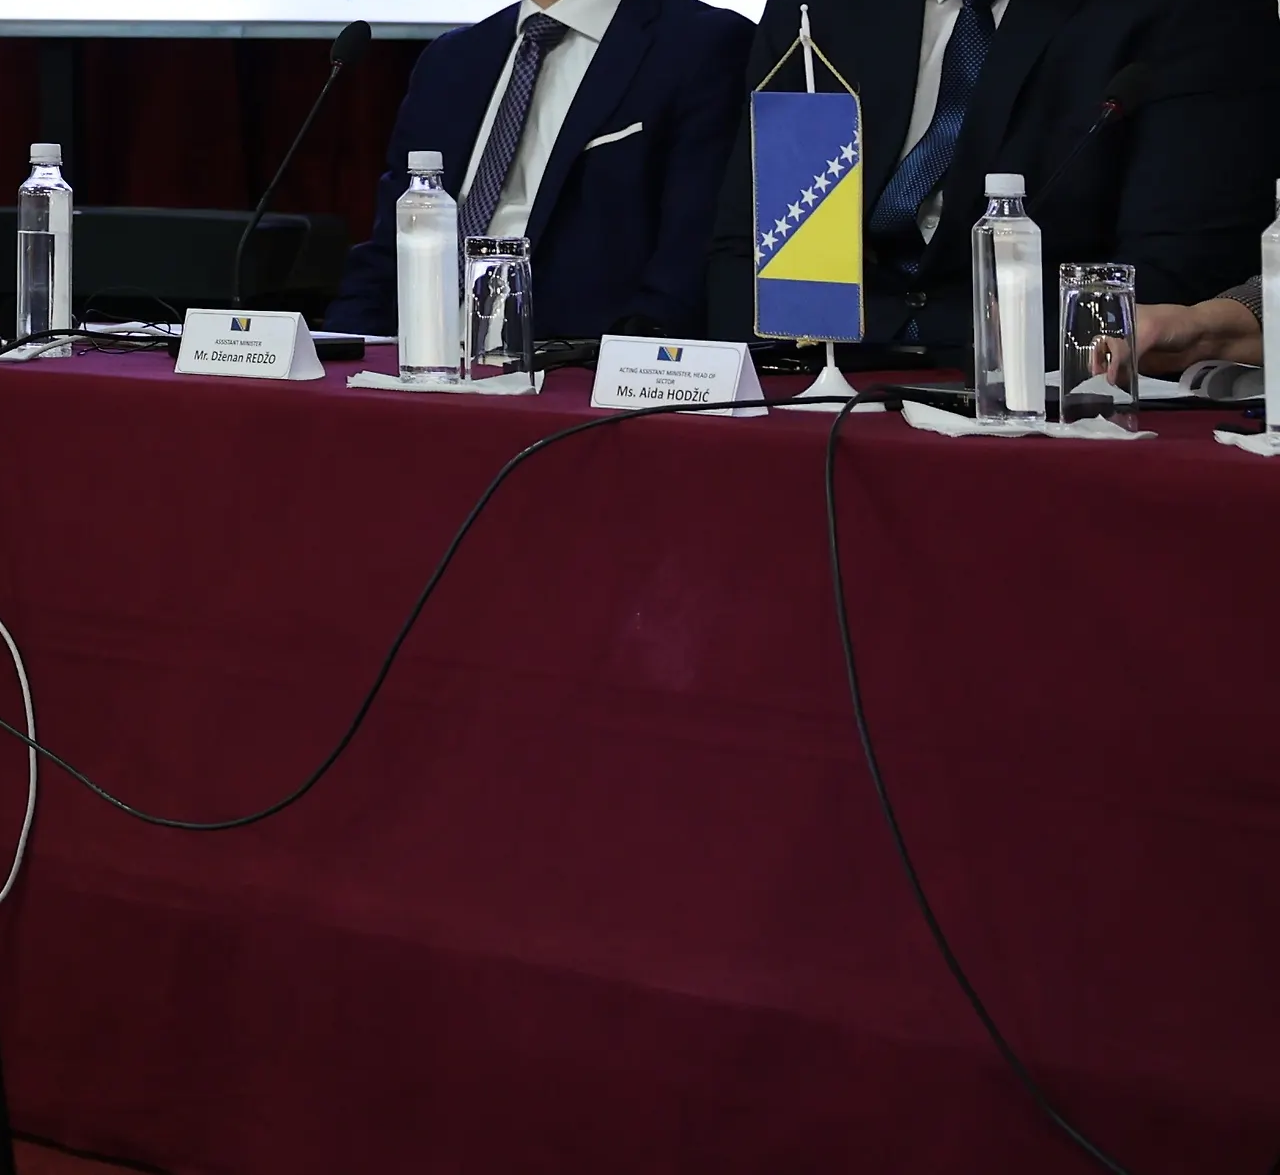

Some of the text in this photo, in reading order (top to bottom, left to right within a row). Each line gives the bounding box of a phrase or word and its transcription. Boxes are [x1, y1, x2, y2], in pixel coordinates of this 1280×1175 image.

[194, 350, 276, 364] Mr. Dženan REDŽO
[693, 371, 708, 379] HEAD
[656, 377, 675, 385] SECTOR
[616, 385, 710, 402] Ms. Aida HODŽIĆ
